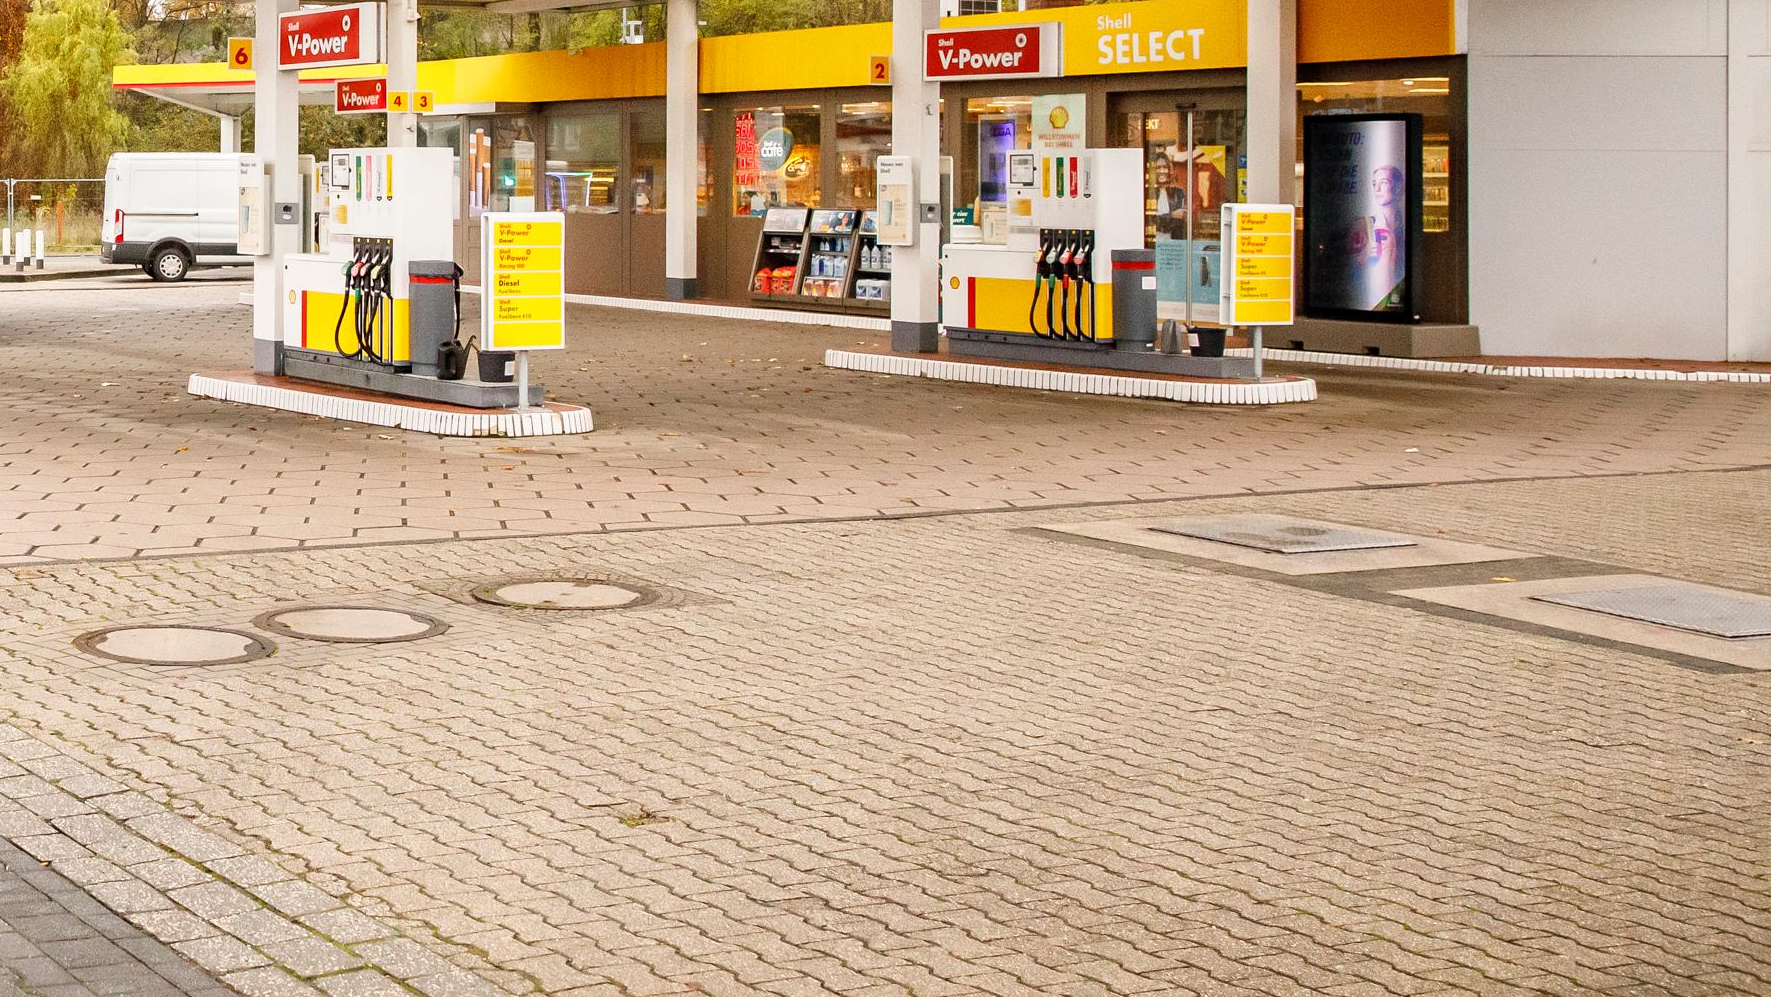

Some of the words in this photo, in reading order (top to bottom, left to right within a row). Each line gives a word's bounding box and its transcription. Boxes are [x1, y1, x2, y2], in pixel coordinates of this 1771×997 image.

[287, 22, 300, 32] Shell
[1097, 12, 1132, 31] Shell
[287, 33, 348, 57] V-Power
[938, 38, 954, 47] Shell
[1097, 28, 1205, 65] SELECT
[235, 47, 249, 65] 6
[938, 49, 1023, 70] V-Power
[875, 63, 886, 79] 2
[342, 92, 380, 107] V-Power
[393, 96, 402, 107] 4
[420, 96, 428, 108] 3
[1037, 133, 1081, 141] WILLKOMMEN
[498, 279, 520, 287] Diesel
[499, 305, 519, 313] Super
